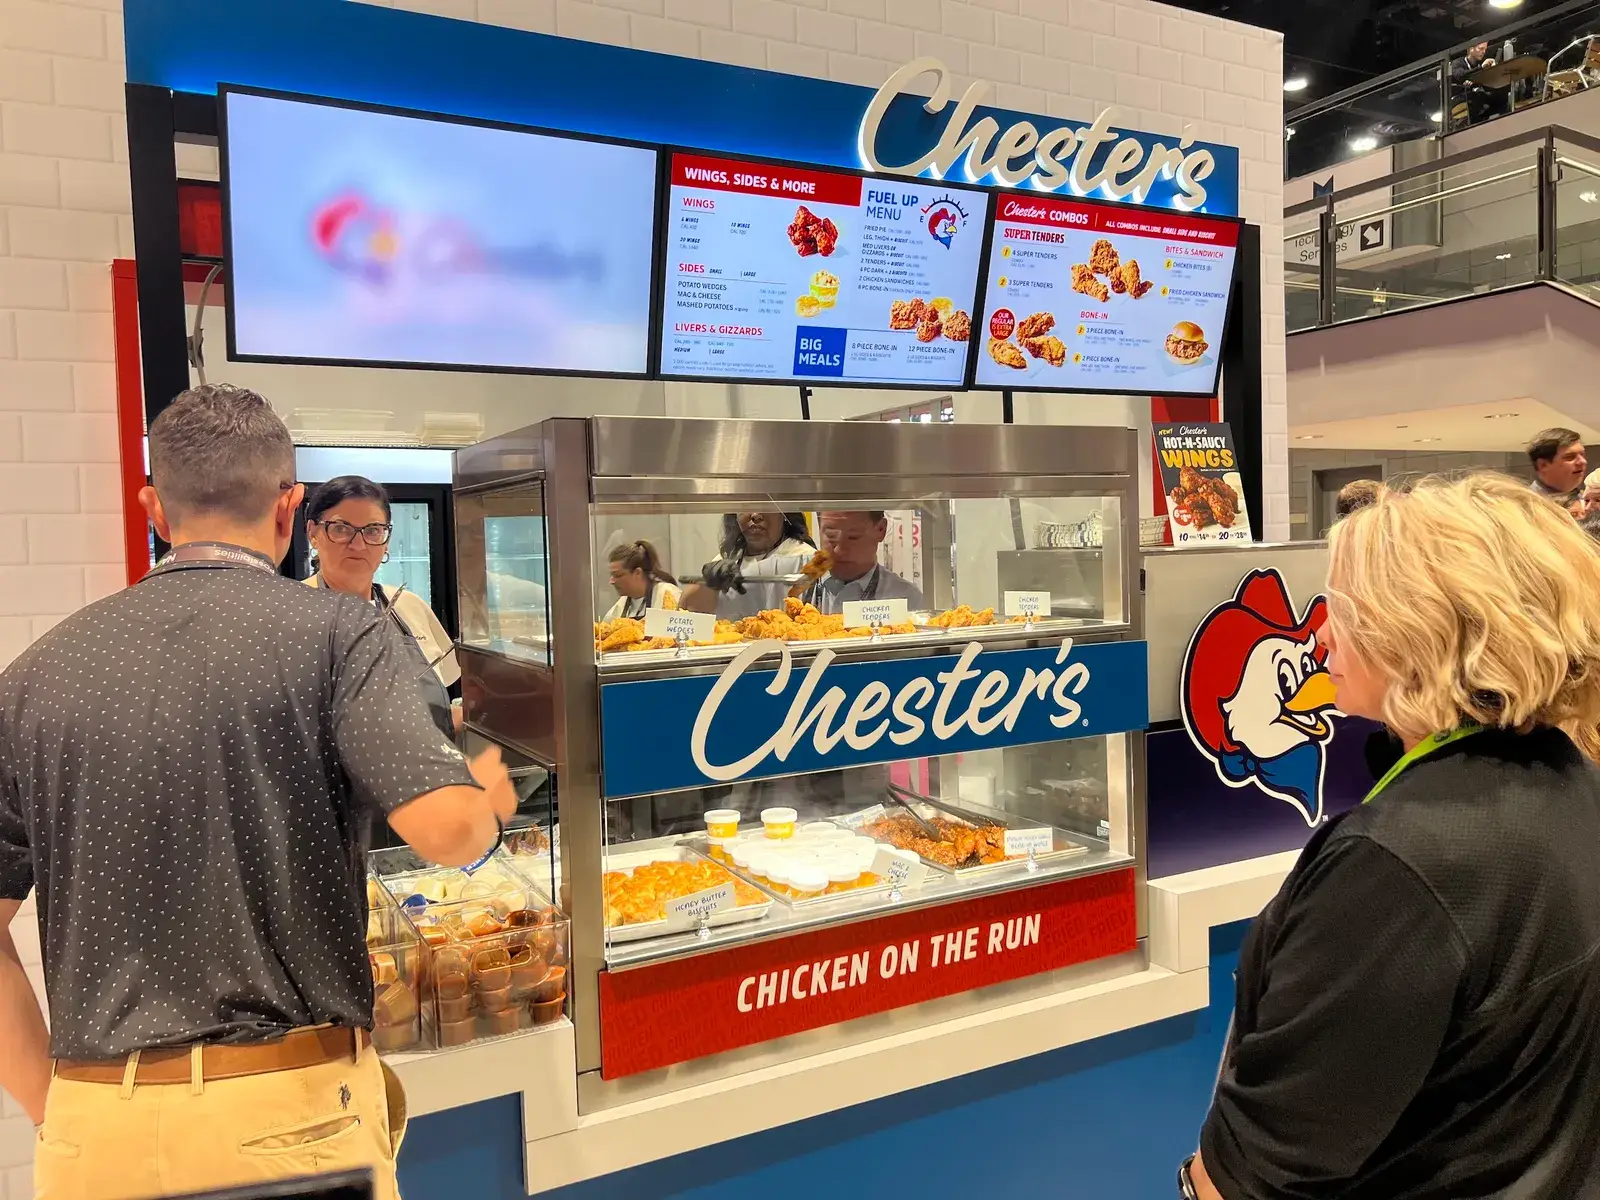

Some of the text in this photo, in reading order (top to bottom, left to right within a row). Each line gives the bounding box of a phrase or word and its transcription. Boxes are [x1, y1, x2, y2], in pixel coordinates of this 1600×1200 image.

[858, 59, 1214, 210] Chester's
[685, 167, 816, 194] WINGS, SIDES & MORE
[683, 197, 715, 209] WINGS
[868, 190, 918, 207] FUEL UP
[866, 206, 901, 220] MENU
[1004, 201, 1088, 224] Chester's COMBOS
[1117, 222, 1138, 231] COMBOS
[1140, 224, 1161, 233] INCLUDE
[1004, 228, 1065, 244] SUPER TENDERS
[862, 249, 885, 257] GIZZARDS
[1017, 250, 1033, 258] SUPER
[1034, 252, 1057, 260] TENDERS
[1165, 246, 1183, 254] BITES
[1190, 248, 1224, 259] SANDWICH
[1300, 242, 1348, 262] Seres
[865, 258, 886, 266] TENDERS
[1173, 262, 1193, 270] CHICKEN
[1193, 263, 1206, 271] BITES
[679, 263, 704, 273] SIDES
[678, 281, 701, 289] POTATO
[884, 278, 914, 286] SANDWICHES
[1031, 281, 1053, 289] TENDERS
[698, 292, 721, 300] CHEESE
[1182, 289, 1202, 297] CHICKEN
[1202, 291, 1226, 299] SANDWICH
[677, 301, 703, 309] MASHED
[704, 302, 733, 311] POTATOES
[1080, 311, 1108, 320] BONE-IN
[675, 322, 762, 336] LIVERS & GIZZARDS
[800, 338, 822, 351] BIG
[932, 346, 955, 354] BONE-IN
[799, 352, 840, 367] MEALS
[1159, 426, 1208, 436] NEW! Chester's
[1163, 437, 1226, 448] HOT-N-SAUCY
[1161, 450, 1234, 468] WINGS
[1179, 532, 1188, 541] 10
[1219, 532, 1229, 540] 20
[862, 605, 890, 613] CHICKEN
[669, 617, 693, 625] POTATO
[690, 638, 1091, 780] Chester's
[892, 861, 905, 869] MAC
[888, 867, 908, 879] CHEESE
[675, 890, 727, 912] HONEY BUTTER
[687, 902, 717, 917] BISCUITS
[736, 950, 870, 1013] CHICKEN
[879, 945, 920, 979] ON
[930, 927, 978, 967] THE
[988, 914, 1042, 954] RUN
